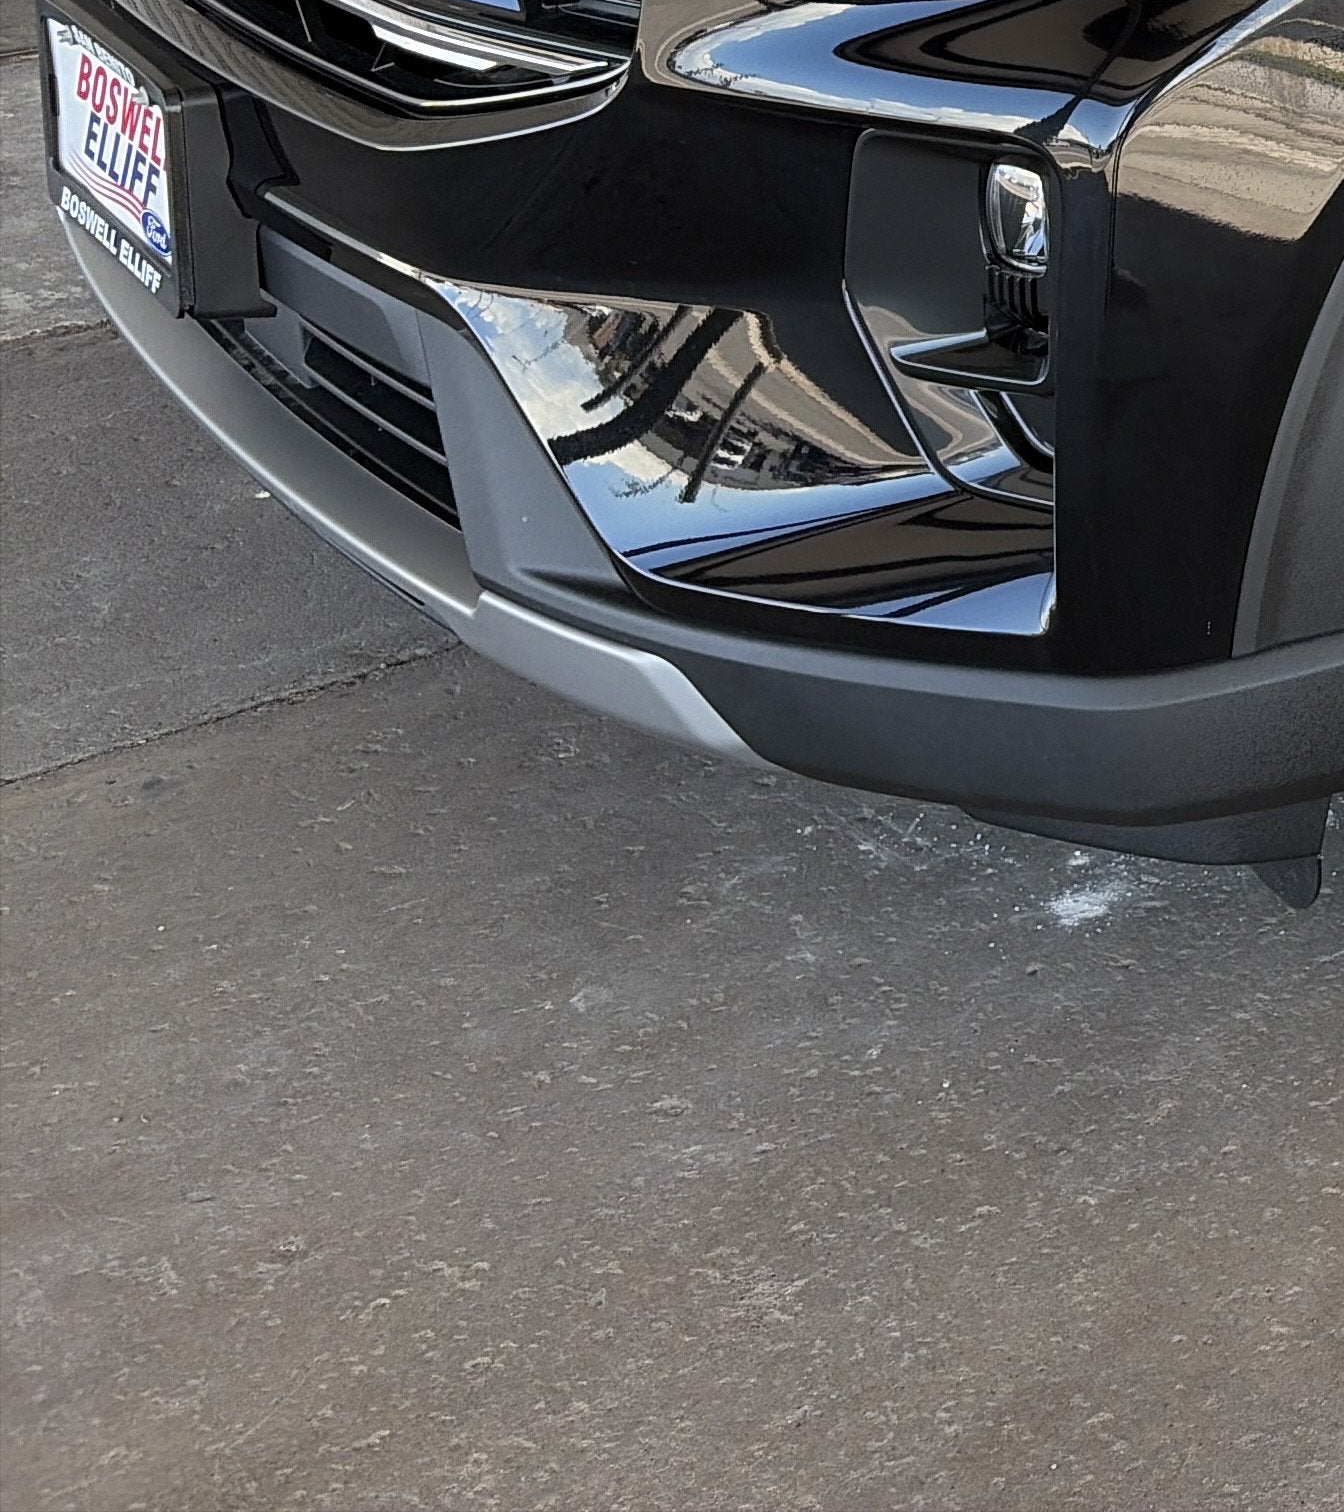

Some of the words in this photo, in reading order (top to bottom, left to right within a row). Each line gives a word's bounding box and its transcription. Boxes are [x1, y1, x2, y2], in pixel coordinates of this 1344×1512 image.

[76, 52, 162, 168] BOSWEL
[83, 110, 161, 208] ELLIFF
[61, 185, 118, 256] BOSWELL
[118, 238, 162, 294] ELLIFF
